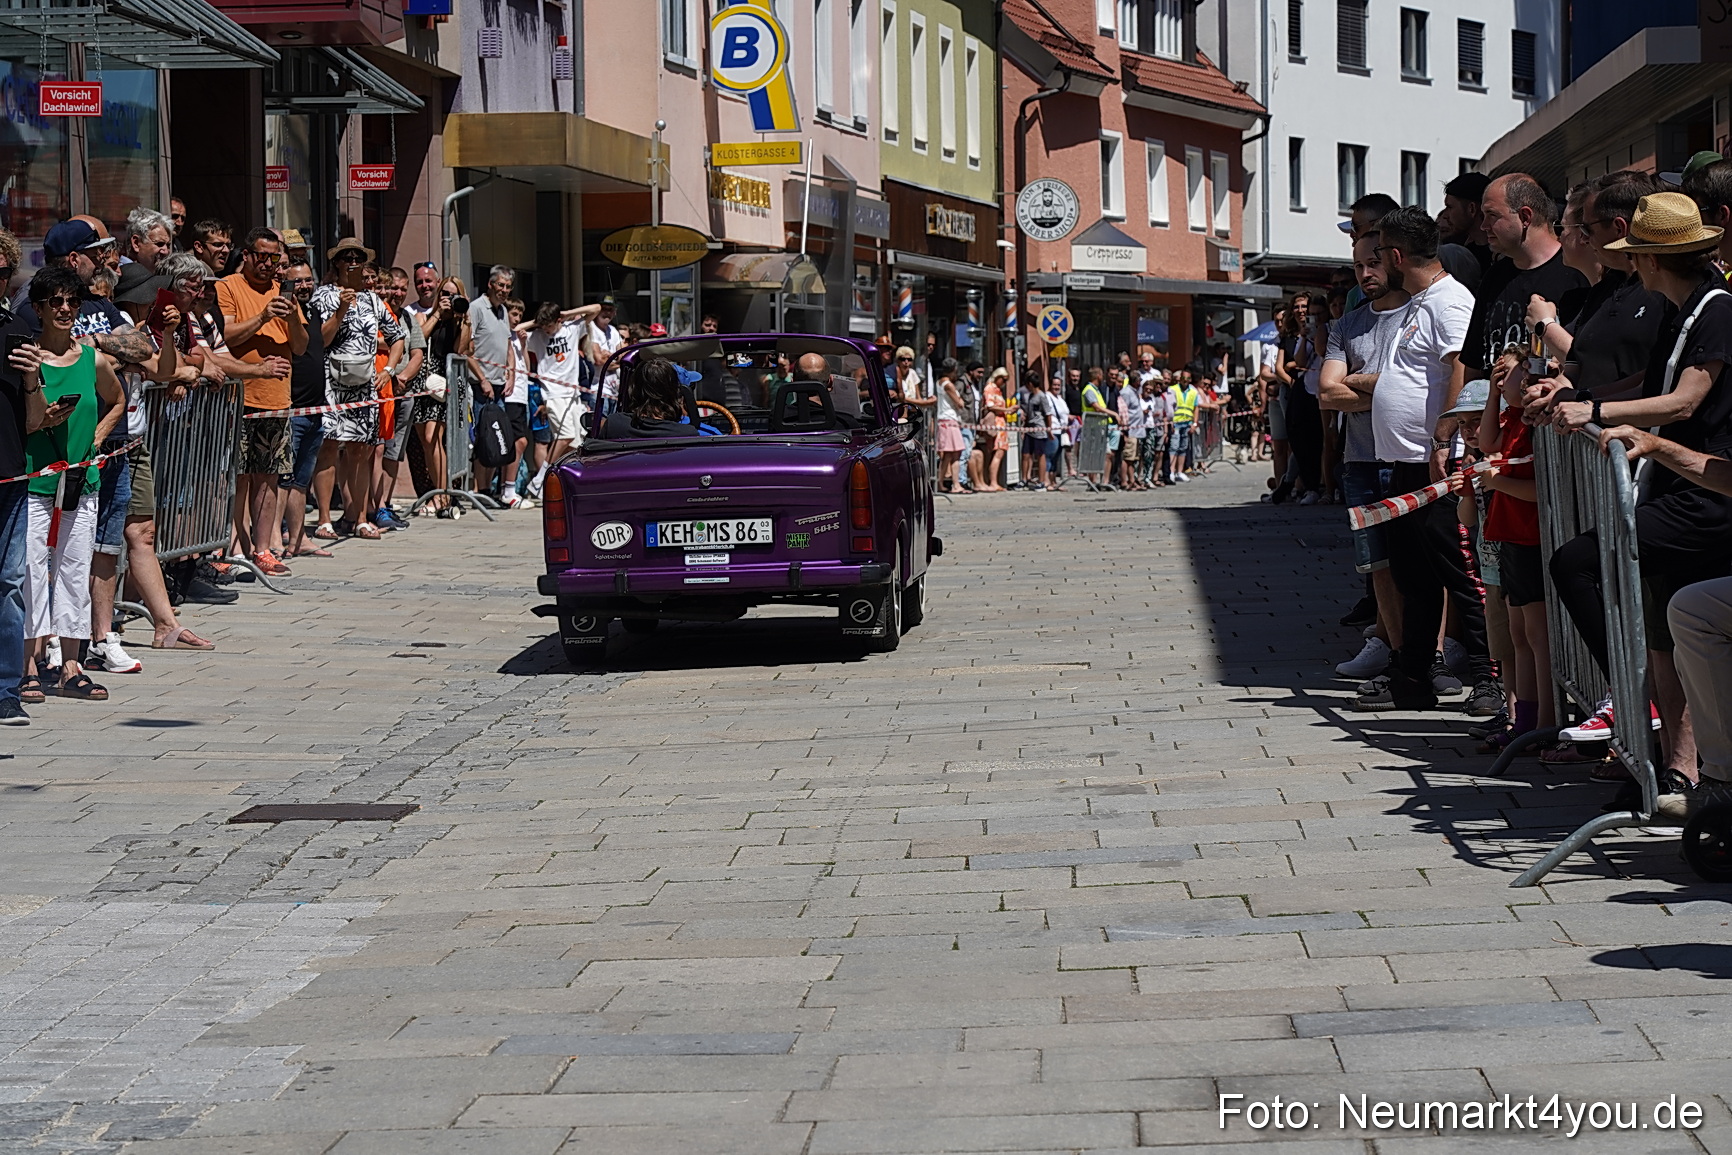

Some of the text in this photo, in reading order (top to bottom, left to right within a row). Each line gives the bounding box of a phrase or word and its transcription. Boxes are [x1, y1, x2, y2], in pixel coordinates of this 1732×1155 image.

[720, 27, 760, 68] B
[50, 89, 91, 100] Vorsicht
[43, 102, 98, 112] Dachlawine!
[717, 147, 796, 159] KLOSTERGASSE 4
[357, 170, 388, 179] Vorsicht
[1020, 212, 1074, 239] BARBERSHOP
[605, 242, 708, 252] DIE GOLDSCHMIEDE
[1086, 246, 1133, 263] Creppresso
[1069, 277, 1101, 285] Klostergasse
[546, 345, 560, 356] DO
[596, 526, 626, 546] DDR
[659, 521, 758, 544] KEH MS 86
[786, 533, 810, 541] MISTER
